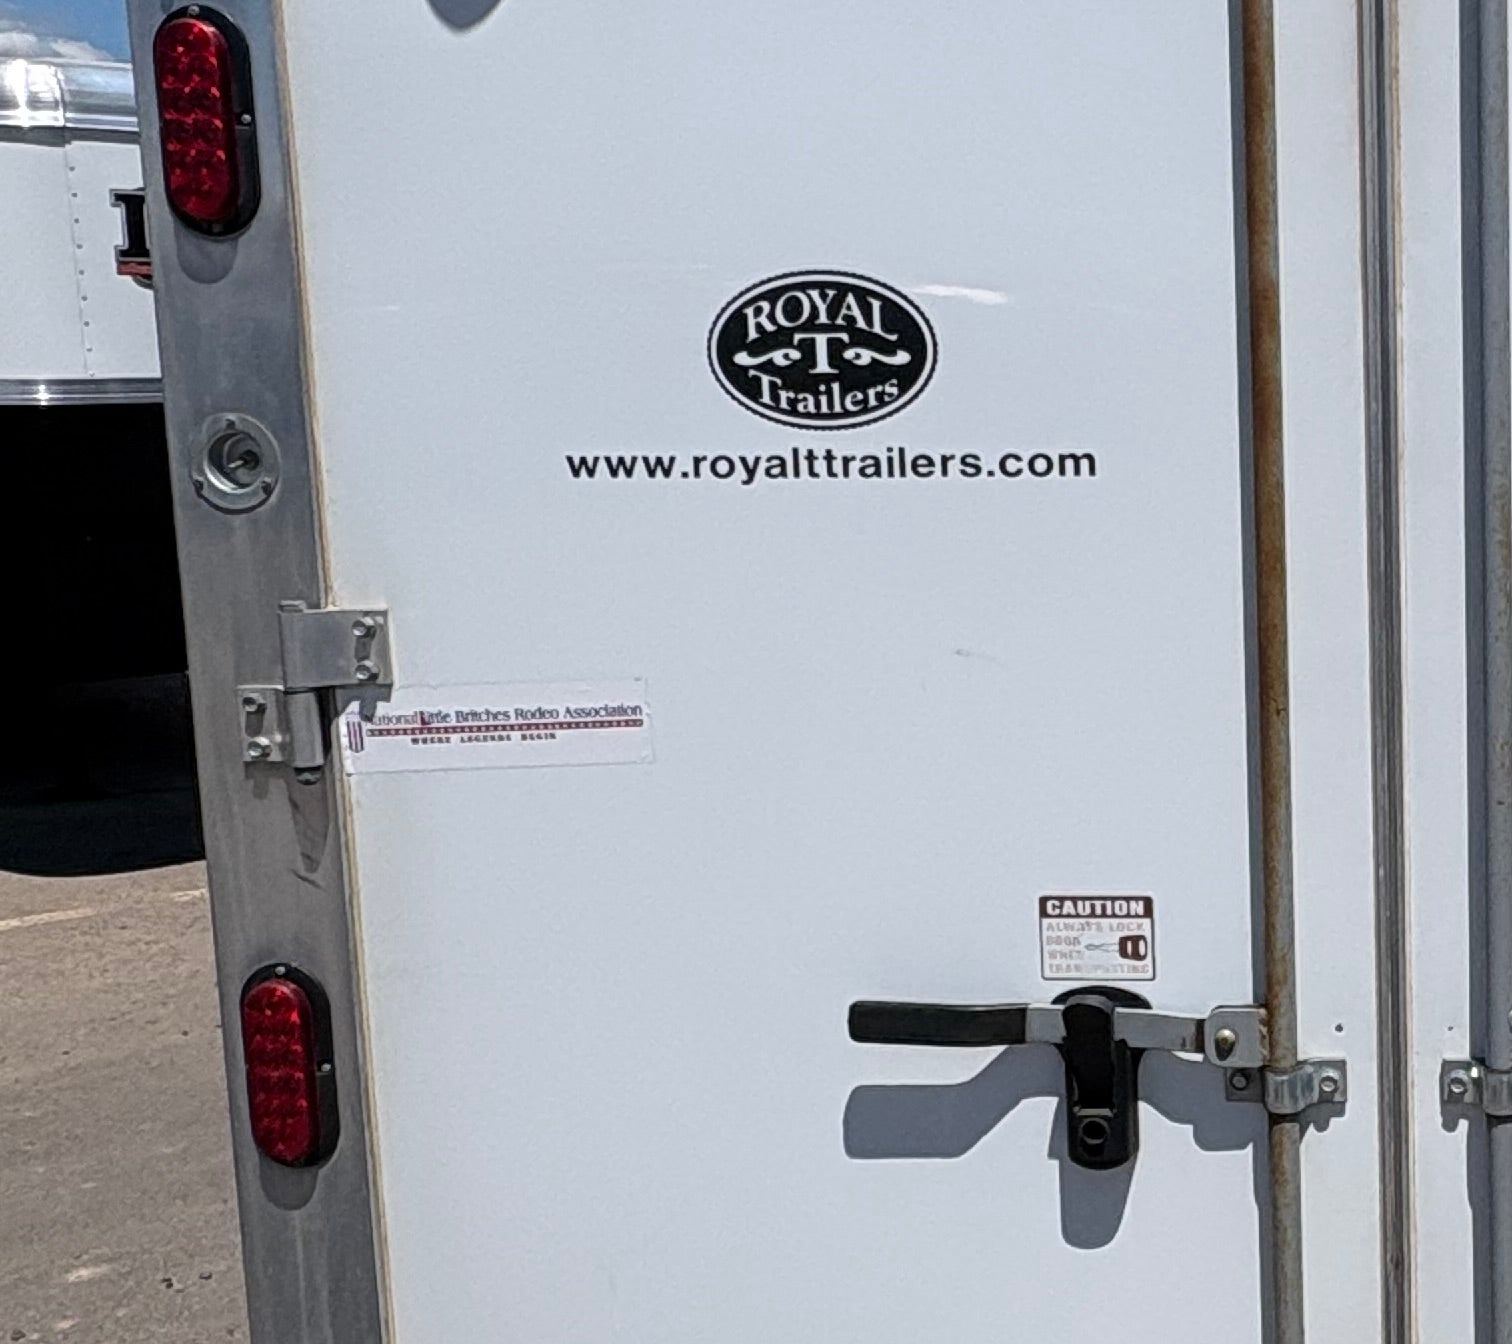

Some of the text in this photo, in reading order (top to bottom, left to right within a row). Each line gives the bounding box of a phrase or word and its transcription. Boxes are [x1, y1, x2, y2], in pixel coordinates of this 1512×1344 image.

[742, 288, 899, 343] ROYAL
[793, 332, 850, 374] T
[748, 369, 900, 414] Trailers
[566, 446, 1098, 485] www.royalttrailers.com
[454, 708, 511, 724] Britches
[514, 707, 560, 721] Rodeo
[563, 703, 643, 719] Association
[1046, 900, 1144, 916] CAUTION
[1109, 921, 1145, 933] LOCK
